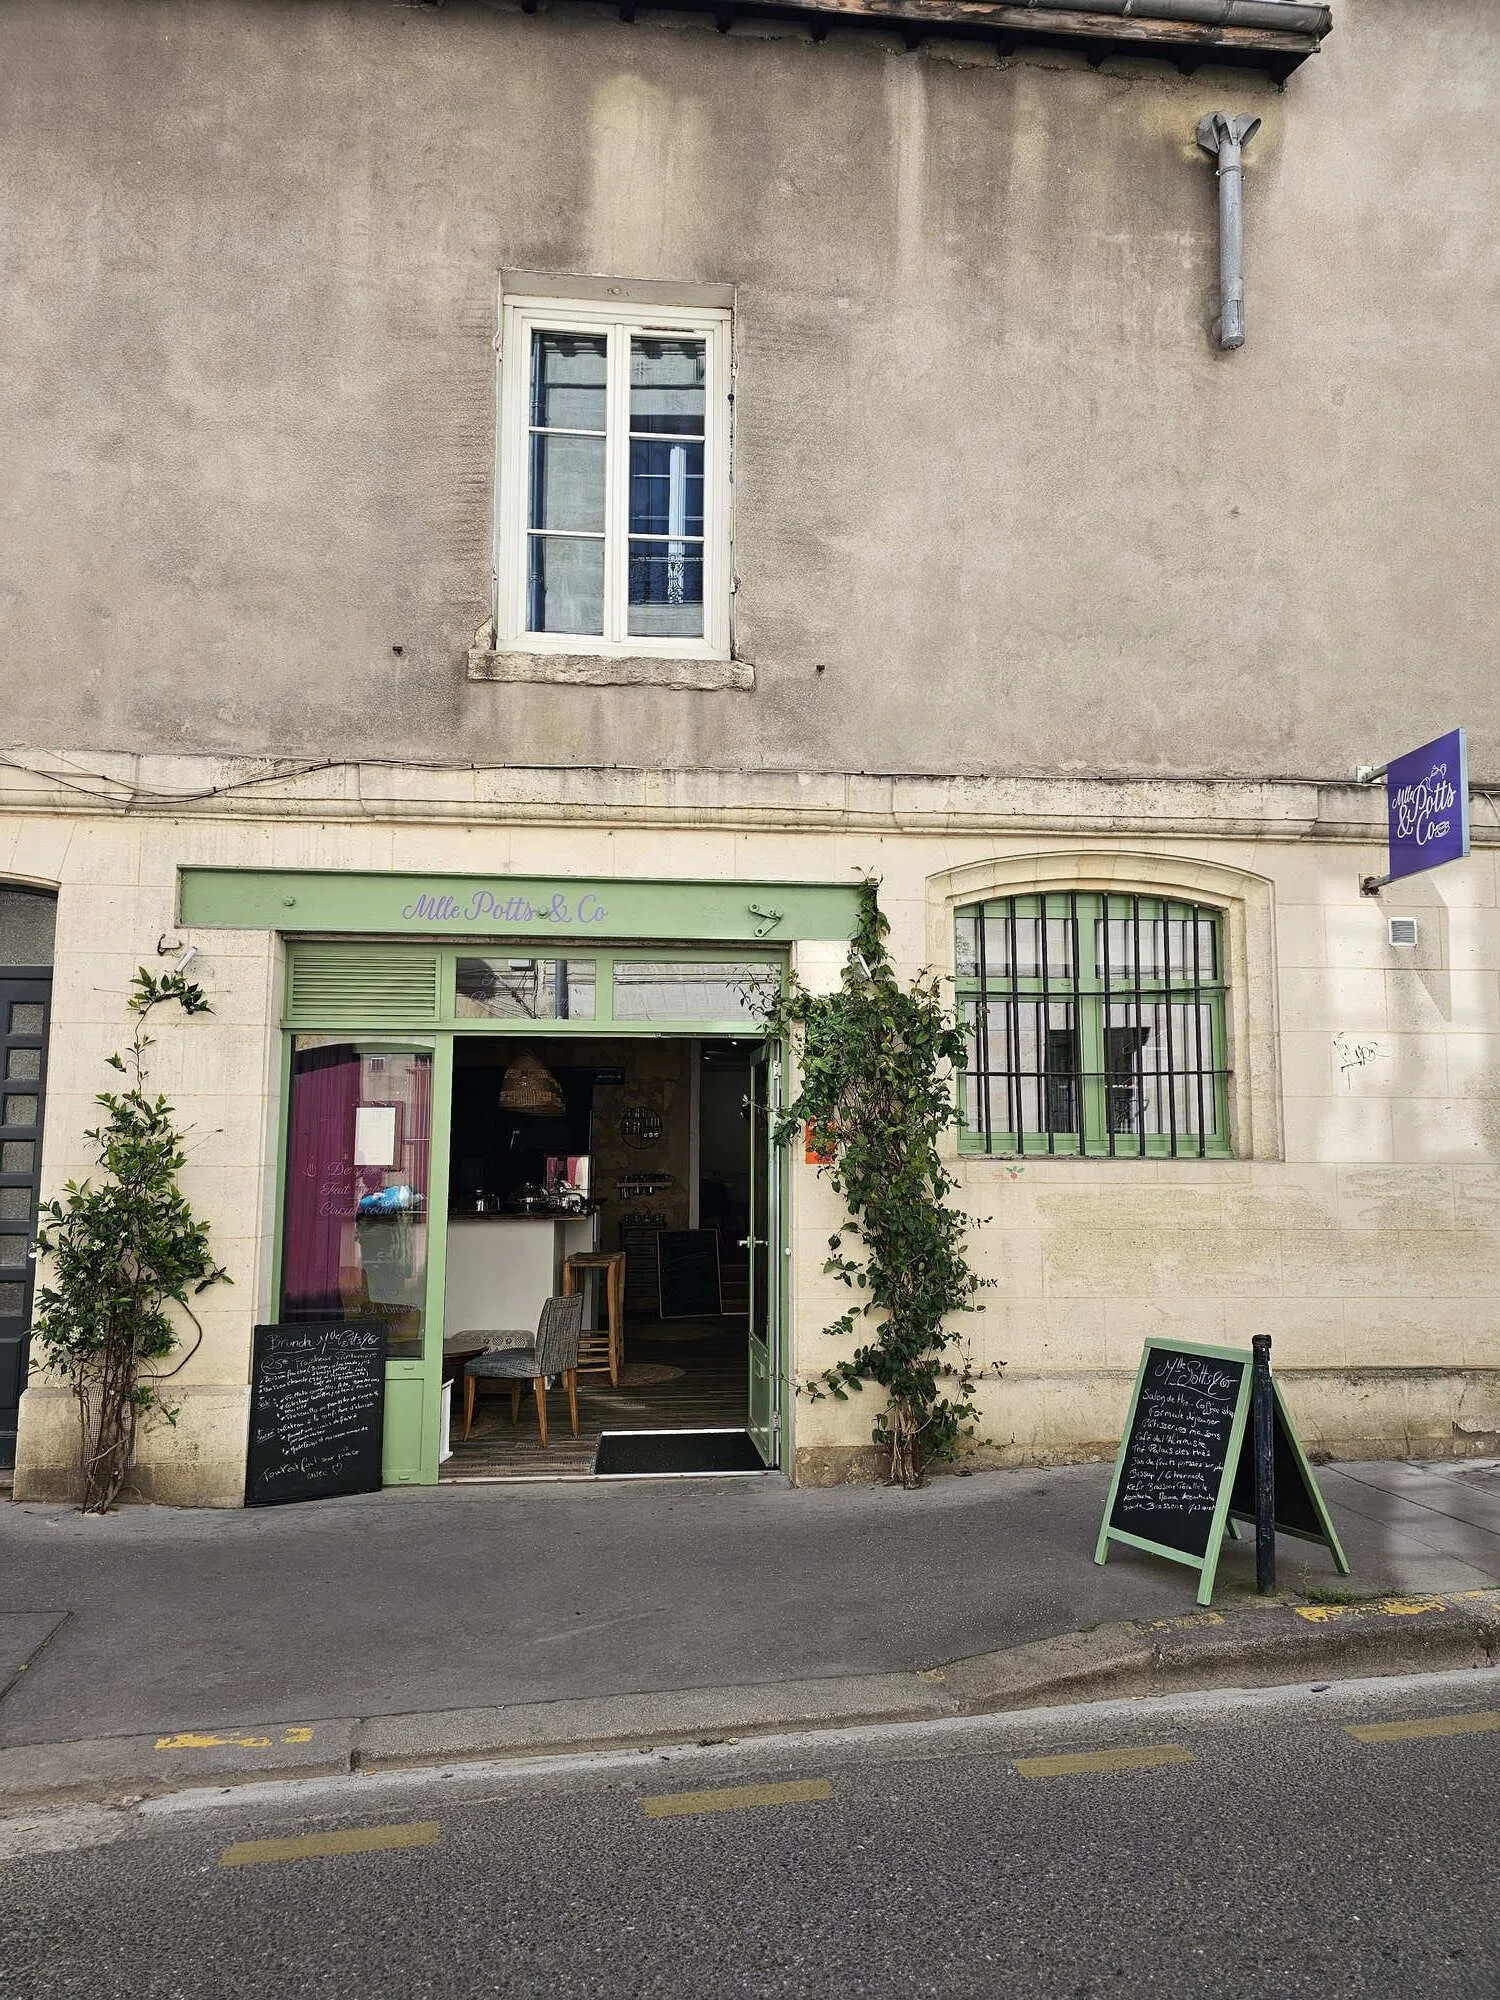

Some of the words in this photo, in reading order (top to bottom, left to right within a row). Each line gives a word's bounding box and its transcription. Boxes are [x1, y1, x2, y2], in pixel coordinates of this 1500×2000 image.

[1392, 785, 1415, 809] Mlle
[1409, 780, 1456, 822] Potts
[1397, 804, 1414, 838] &
[1417, 809, 1436, 845] Co
[402, 893, 460, 921] Mlle
[464, 890, 534, 921] Potts
[550, 893, 572, 923] &
[577, 894, 609, 922] Co
[264, 1334, 313, 1350] Brunch
